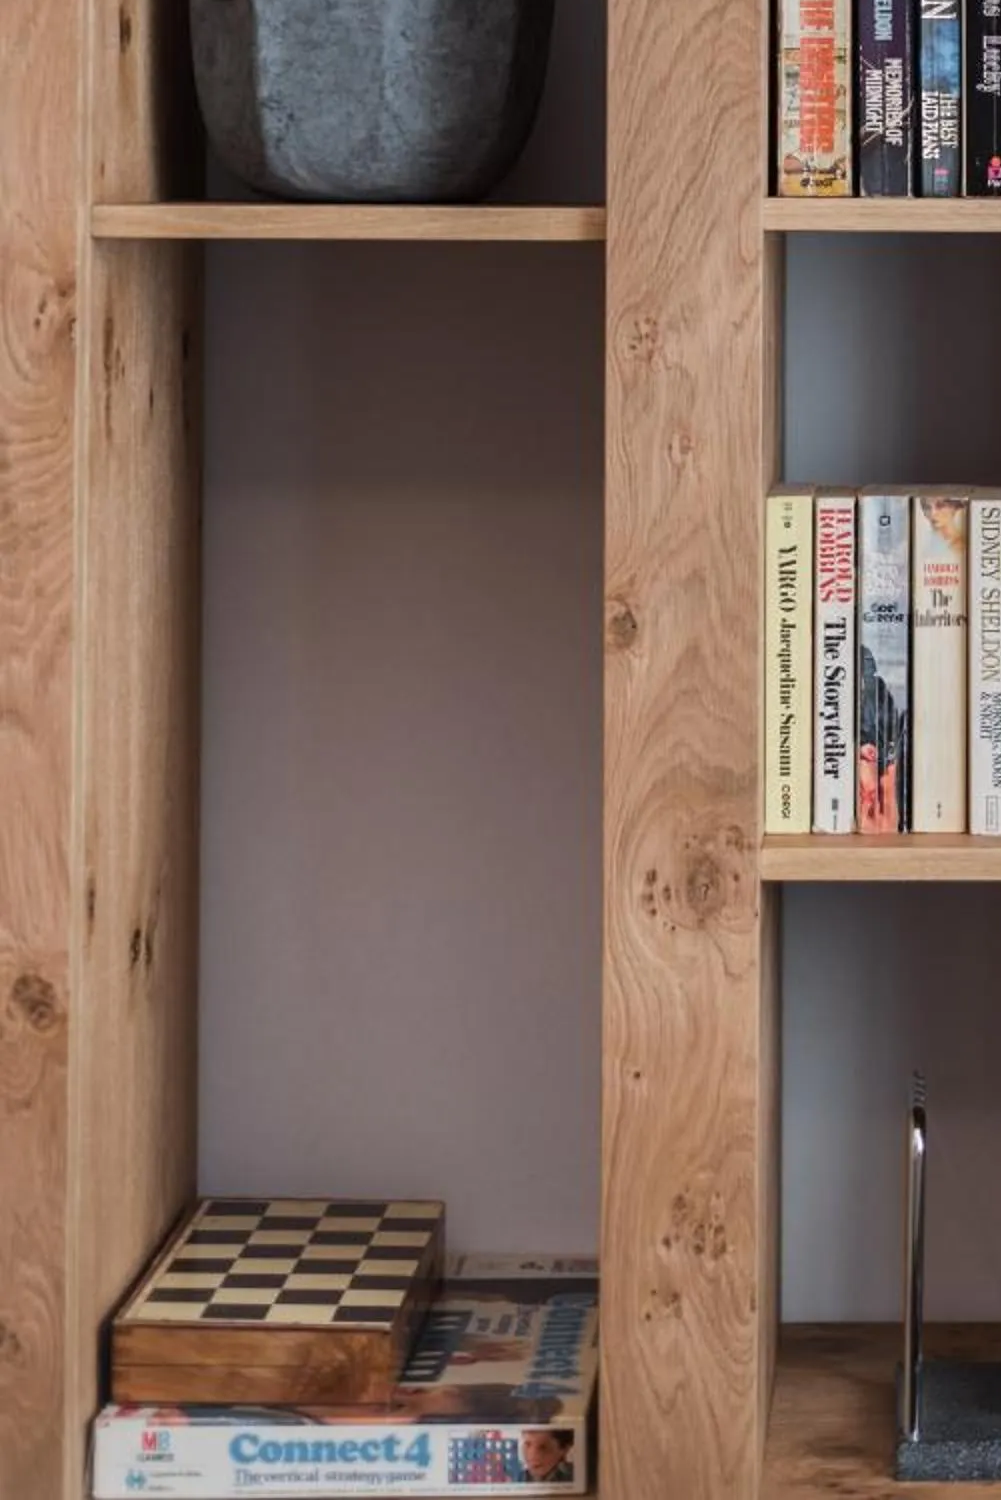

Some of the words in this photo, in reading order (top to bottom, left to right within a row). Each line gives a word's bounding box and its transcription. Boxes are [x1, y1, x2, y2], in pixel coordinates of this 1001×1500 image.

[864, 69, 883, 134] MIDNIGHT
[884, 57, 903, 125] MEMORIES
[921, 90, 939, 119] LAID
[939, 92, 957, 117] THE
[885, 126, 903, 146] OF
[921, 121, 939, 159] PLANS
[939, 118, 957, 149] BEST
[819, 507, 836, 603] ROBBINS
[836, 507, 852, 603] HAROLD
[980, 507, 1001, 581] SIDNEY
[778, 545, 798, 613] YARGO
[823, 617, 846, 660] The
[980, 587, 1001, 682] SHELDON
[776, 617, 797, 710] Jacqueline
[979, 691, 991, 701] &
[819, 665, 846, 780] Storyteller
[979, 703, 992, 740] NIGHT
[779, 713, 797, 777] Susann
[142, 1431, 171, 1452] MB
[229, 1432, 403, 1466] Connect
[404, 1432, 432, 1468] 4
[234, 1469, 263, 1486] The
[263, 1469, 320, 1483] vertical
[324, 1470, 386, 1486] strategy
[386, 1471, 428, 1486] game
